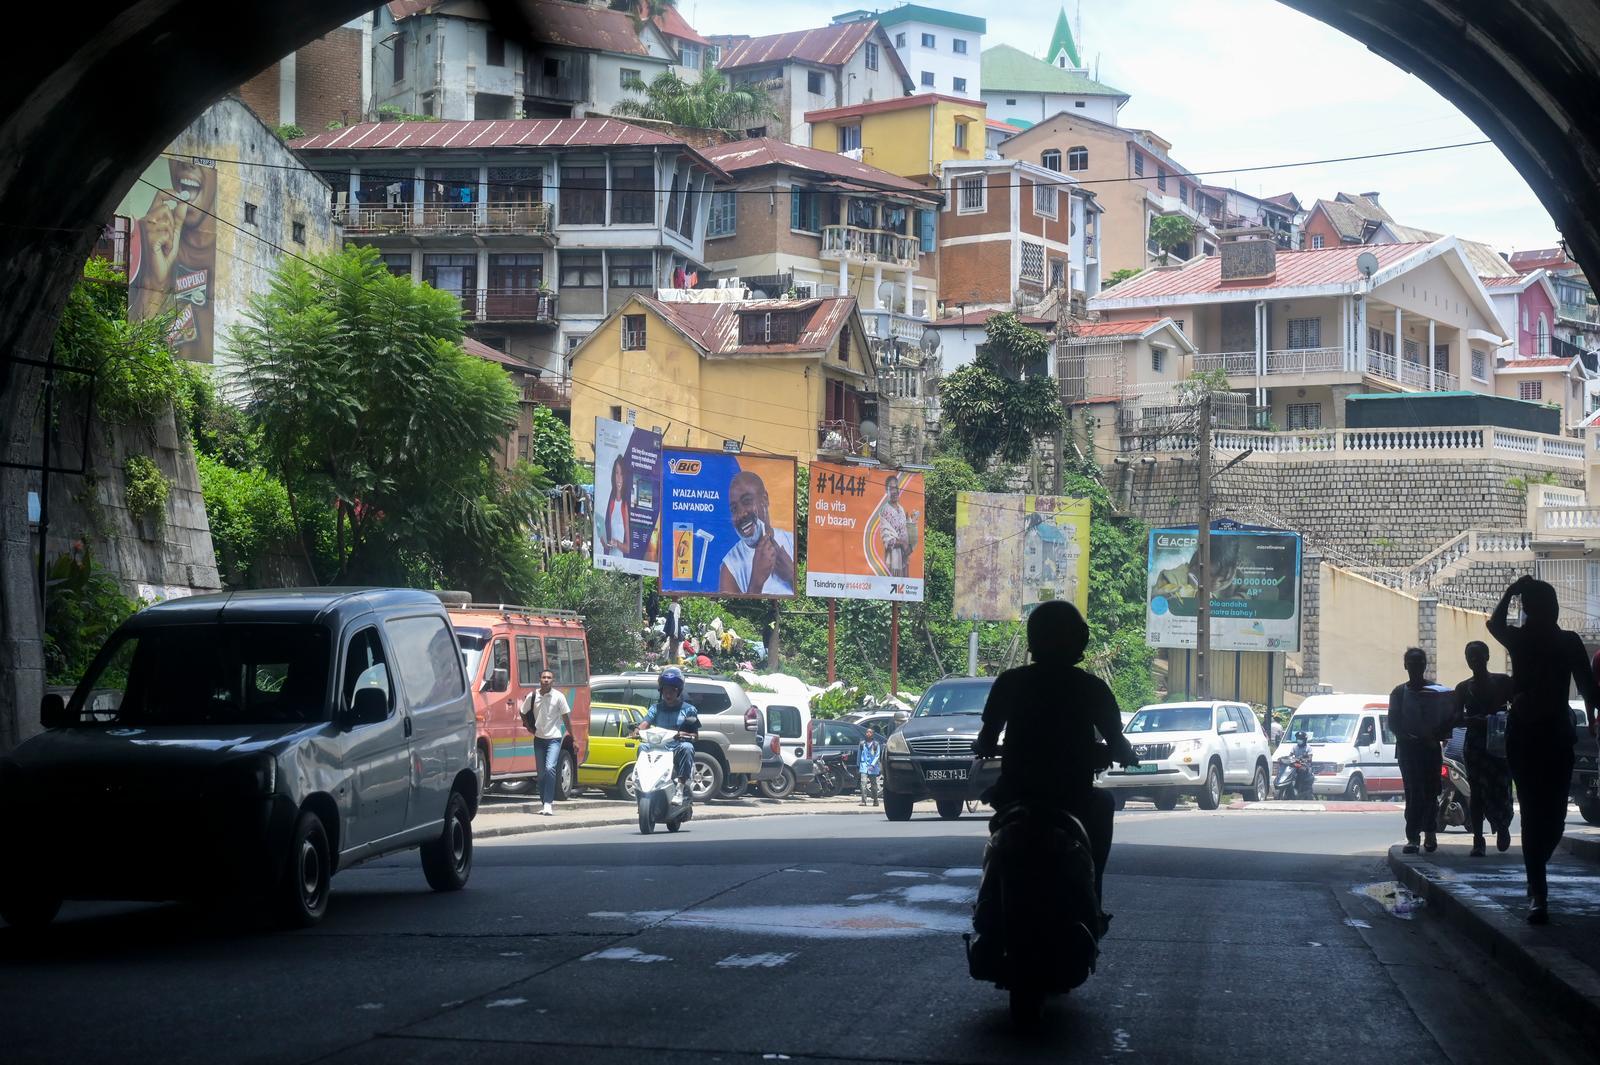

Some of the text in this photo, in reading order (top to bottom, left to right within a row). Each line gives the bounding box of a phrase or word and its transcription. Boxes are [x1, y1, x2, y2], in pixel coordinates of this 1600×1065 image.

[177, 272, 205, 290] KOPIKO
[678, 462, 699, 472] BIC
[816, 472, 866, 497] #144#
[672, 488, 720, 500] N'AIZA N'AIZA
[672, 501, 714, 513] ISAN'ANDRO
[815, 499, 846, 512] dia vita
[815, 514, 856, 528] ny bazary
[1170, 537, 1198, 547] ACEP
[813, 579, 837, 589] Tsindrio
[837, 582, 846, 591] ny
[1243, 578, 1260, 586] 000
[1261, 578, 1277, 586] 000
